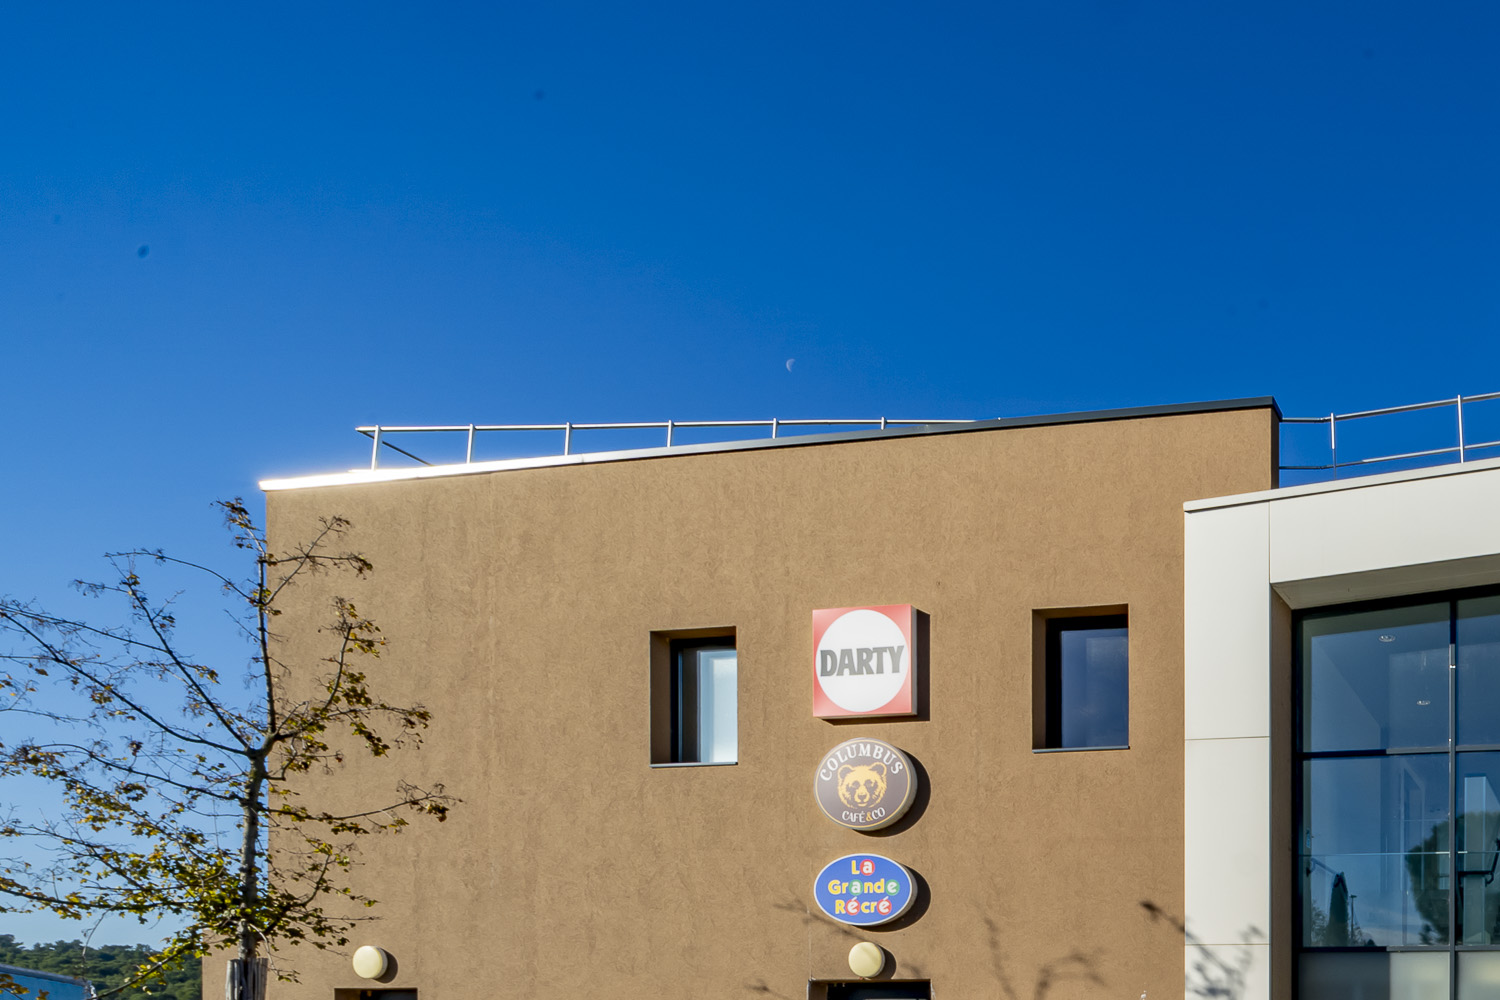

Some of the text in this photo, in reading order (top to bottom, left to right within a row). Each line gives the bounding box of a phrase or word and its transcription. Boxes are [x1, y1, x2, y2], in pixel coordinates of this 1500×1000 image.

[820, 645, 904, 677] DARTY
[820, 743, 904, 781] COLUMBUS
[851, 860, 873, 875] La
[827, 878, 898, 895] Grande
[834, 896, 890, 914] Récré
